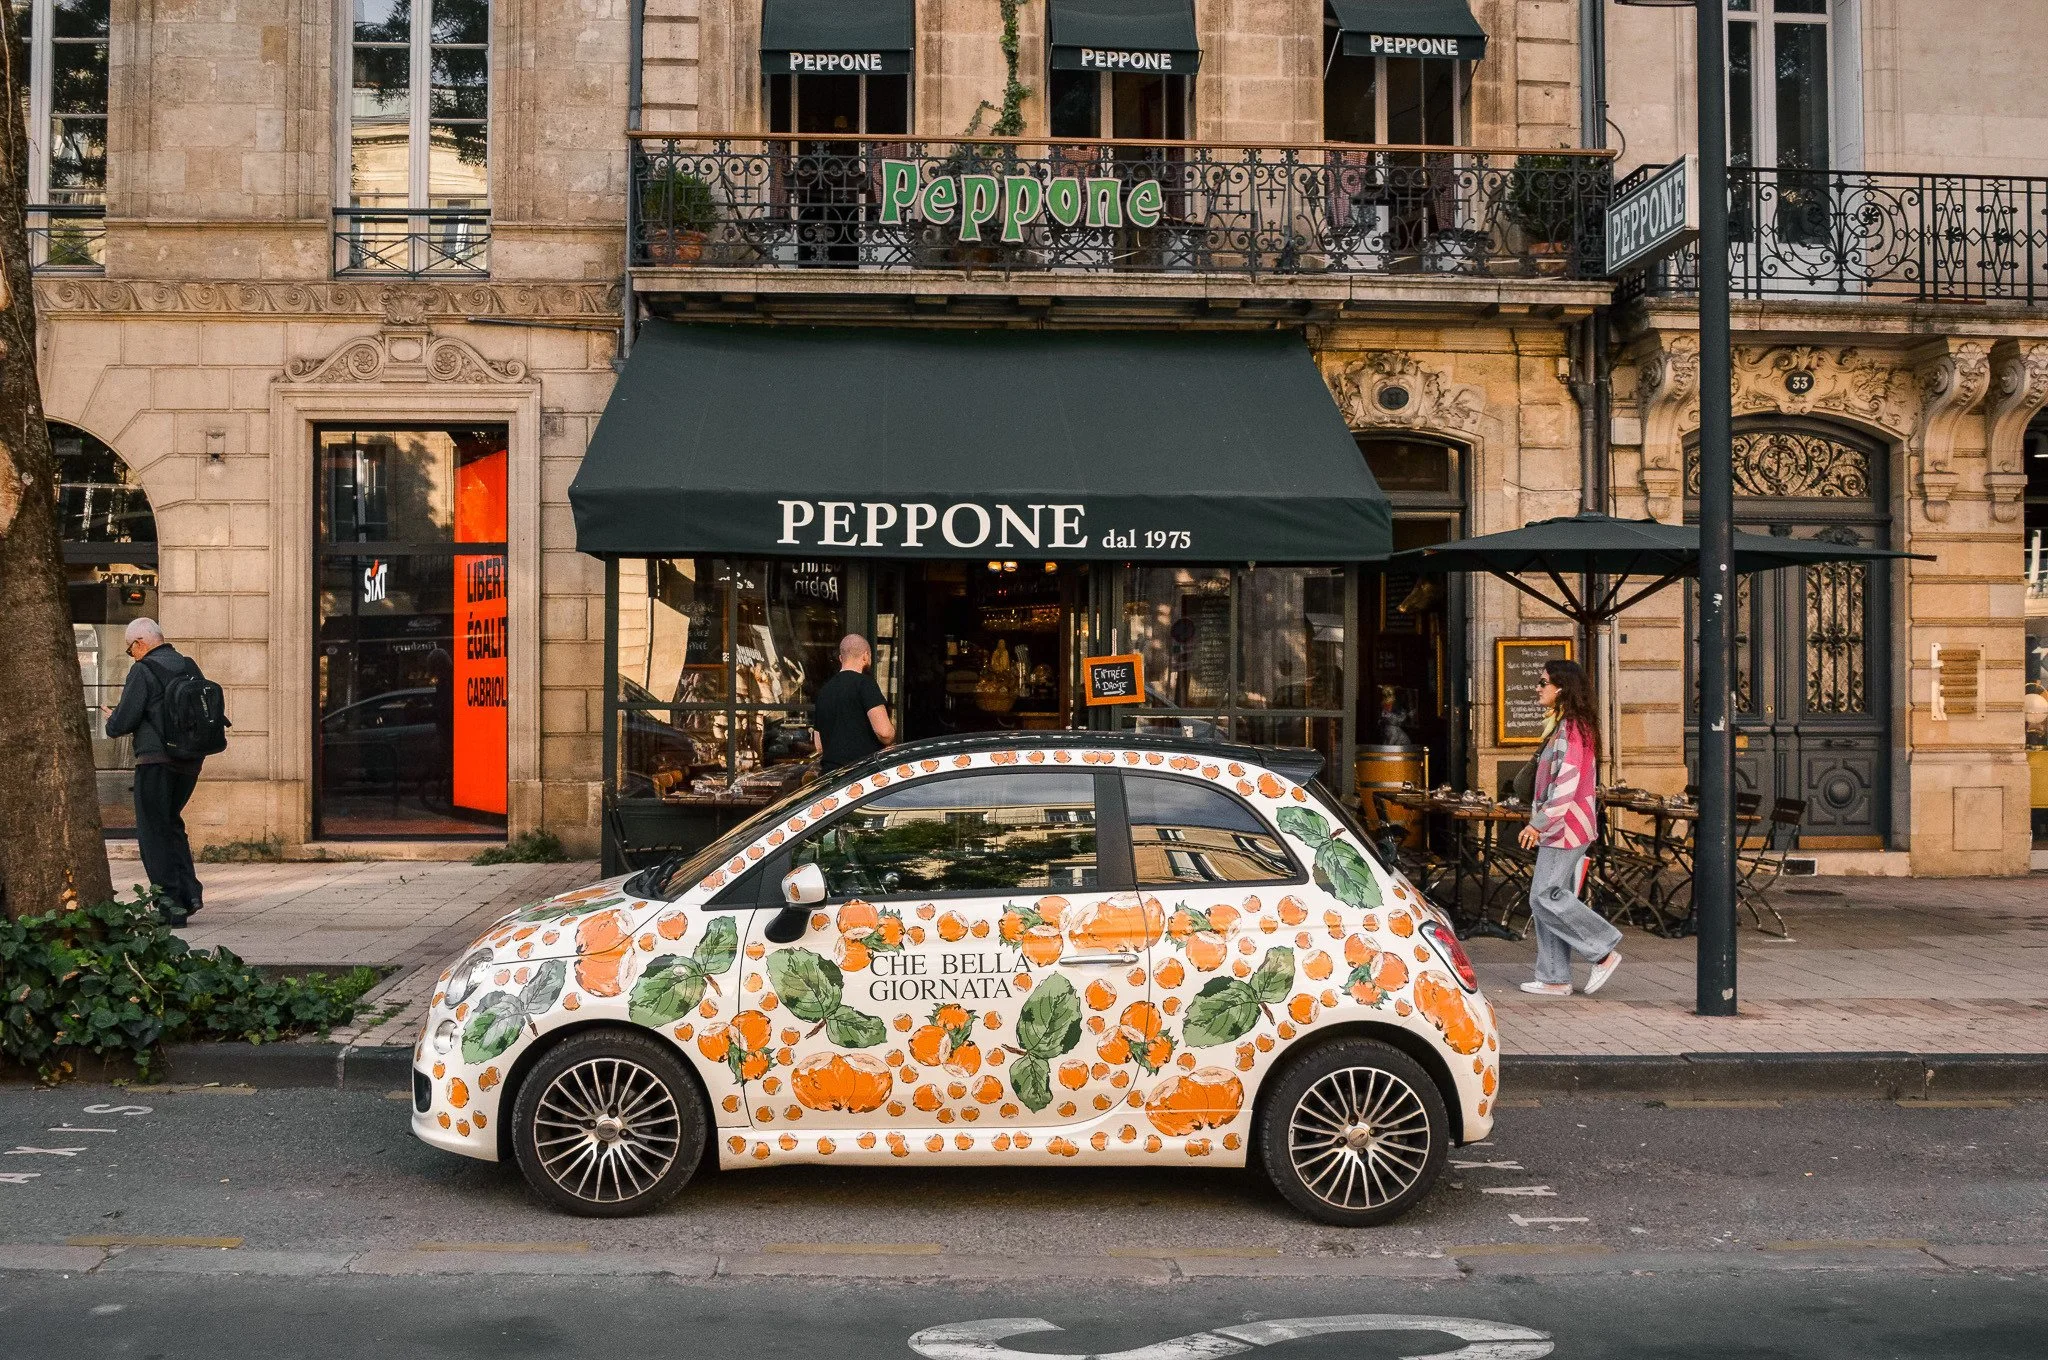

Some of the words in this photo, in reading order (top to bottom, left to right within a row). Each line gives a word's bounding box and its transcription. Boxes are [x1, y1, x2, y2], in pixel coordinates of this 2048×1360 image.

[1369, 34, 1459, 56] PEPPONE
[789, 52, 883, 71] PEPPONE
[1081, 48, 1172, 70] PEPPONE
[879, 158, 1163, 243] Peppone
[1612, 169, 1684, 262] PEPPONE
[1792, 376, 1808, 389] 33
[776, 499, 1088, 549] PEPPONE
[1102, 528, 1137, 549] dal
[1144, 530, 1192, 549] 1975
[1094, 666, 1127, 680] ENTRÉE
[870, 954, 927, 976] CHE
[941, 952, 1032, 975] BELLA
[869, 978, 1012, 1001] GIORNATA
